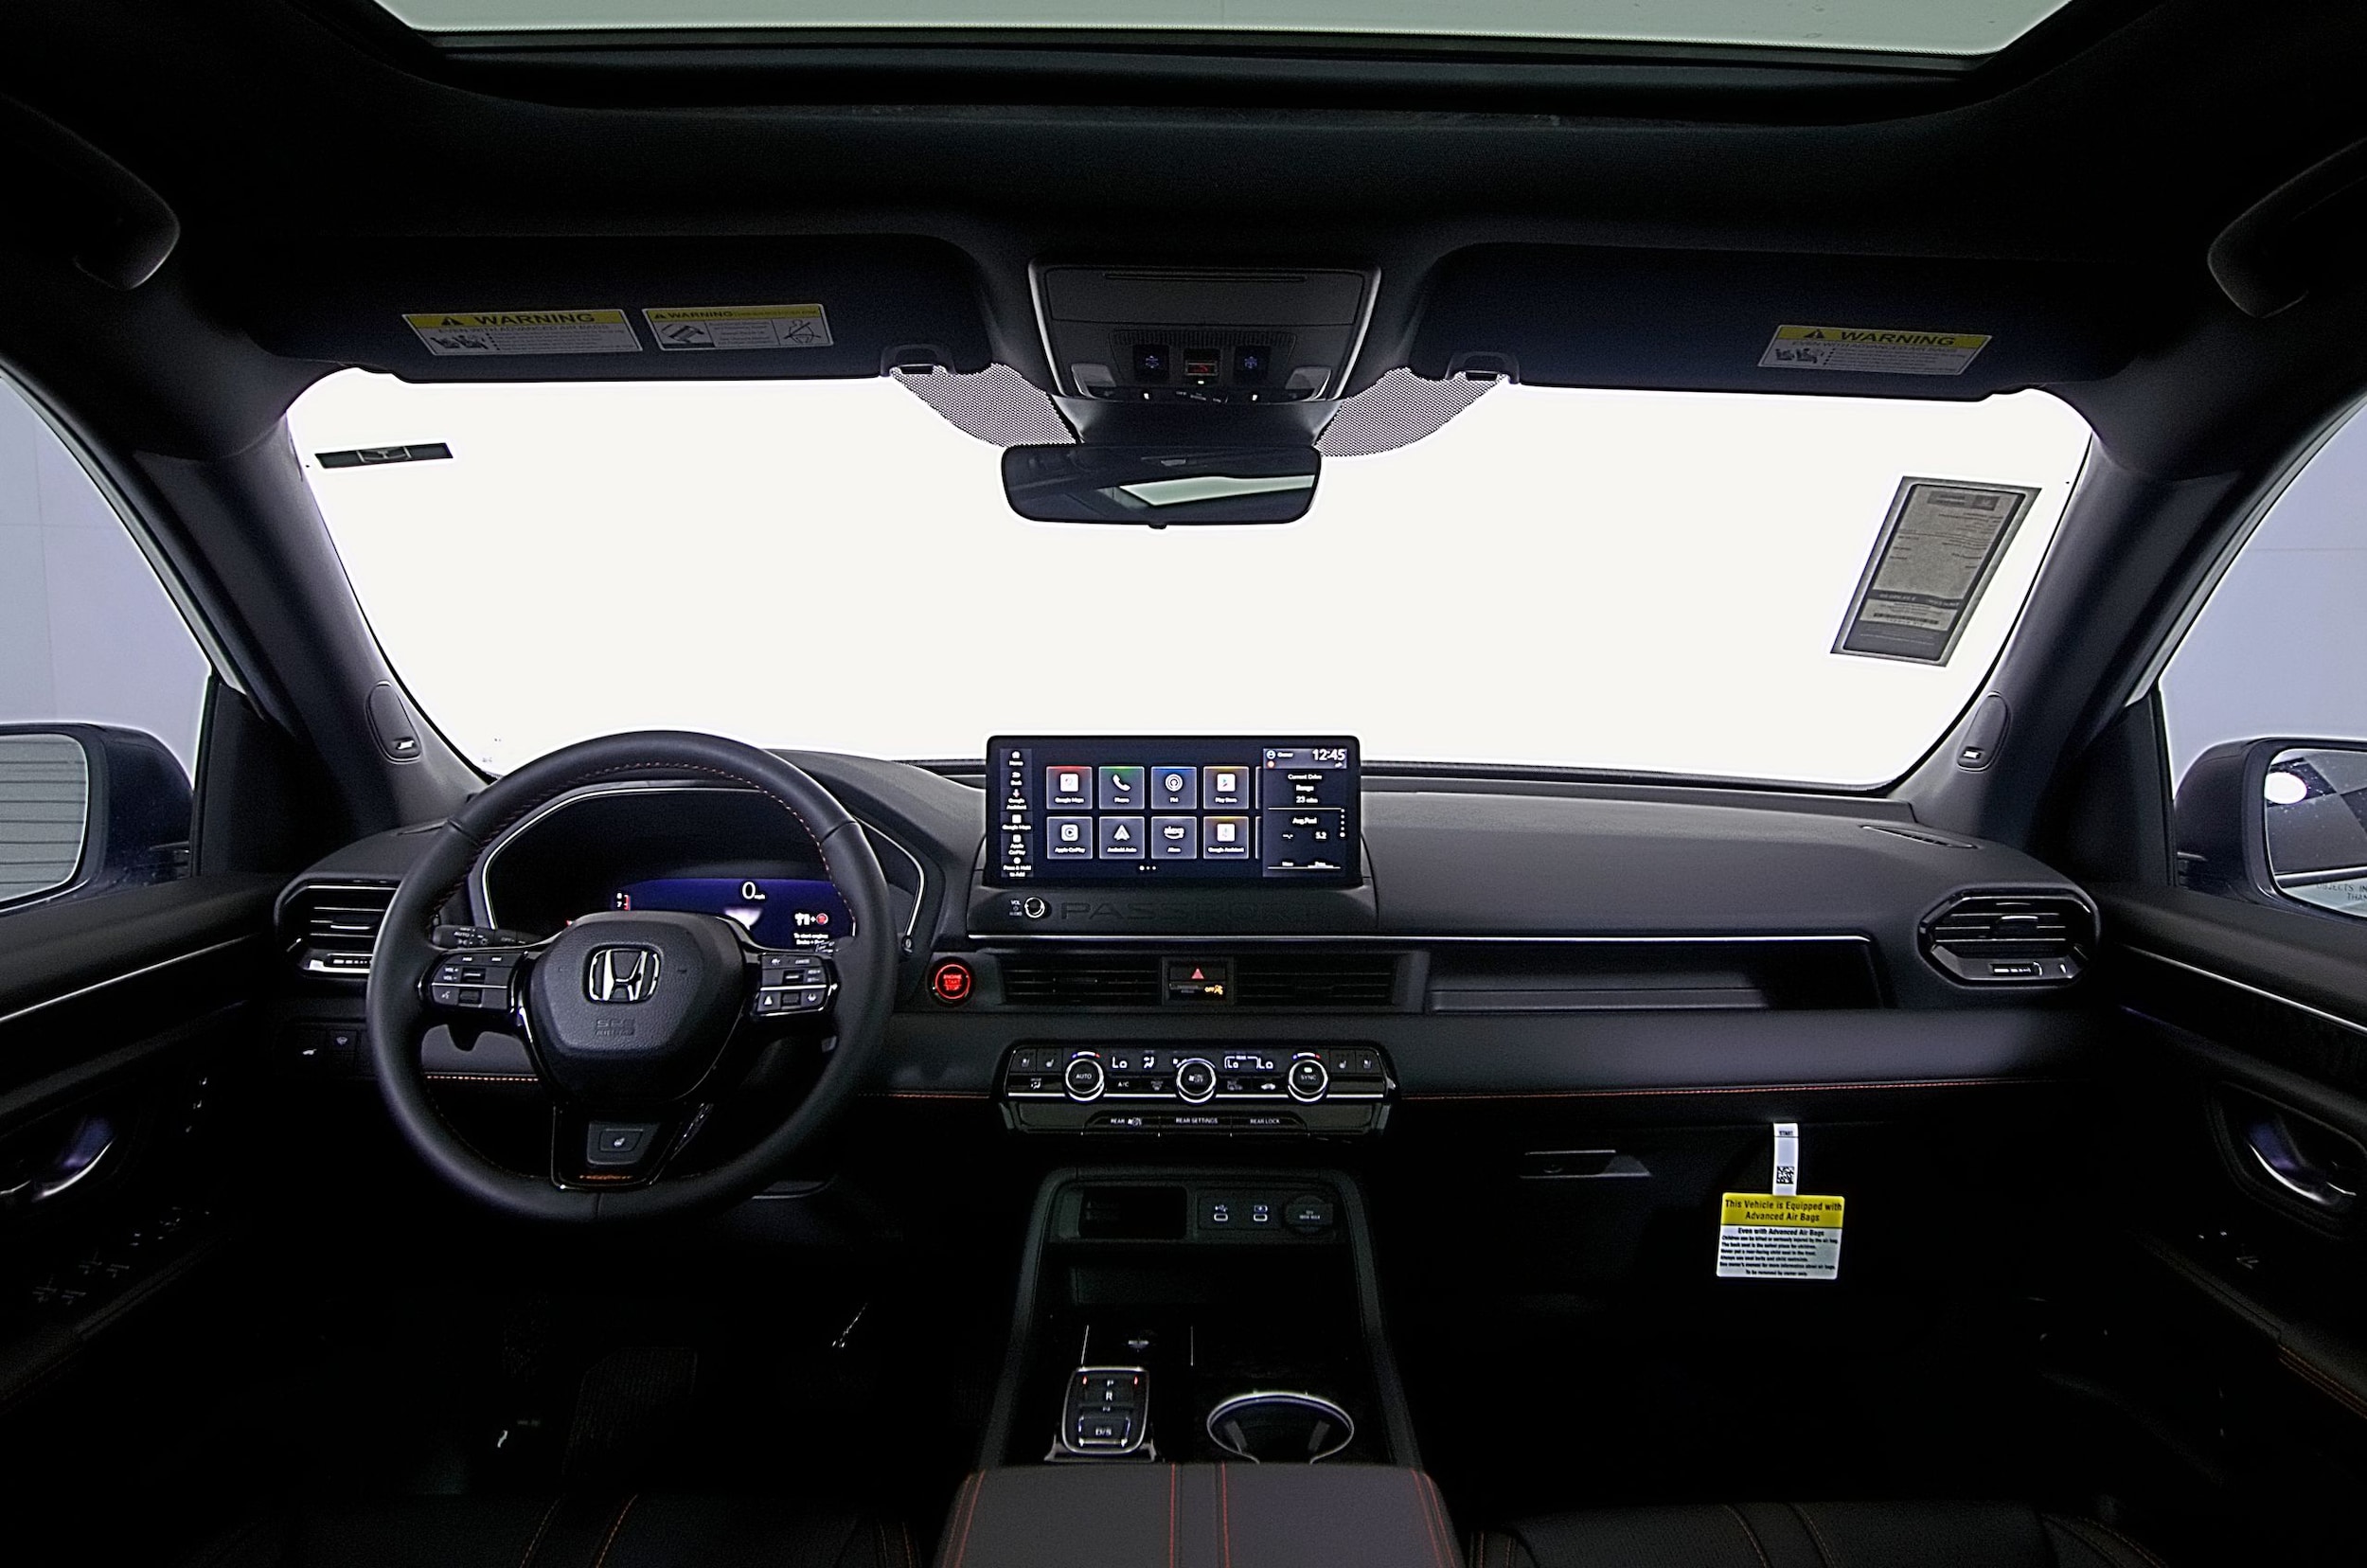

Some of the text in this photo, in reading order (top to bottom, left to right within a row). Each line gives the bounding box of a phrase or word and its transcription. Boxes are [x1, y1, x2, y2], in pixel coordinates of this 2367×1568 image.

[473, 312, 596, 327] WARNING
[1841, 330, 1956, 347] WARNING
[1312, 749, 1345, 761] 12:45
[741, 882, 756, 900] 0
[2317, 883, 2354, 892] OBJECTS
[1059, 900, 1327, 920] PASSPO
[1112, 1056, 1129, 1069] Lo
[1257, 1058, 1274, 1069] Lo
[1725, 1200, 1842, 1211] This Vehicle is Equipped with
[1745, 1211, 1820, 1222] Advanced Air Bags
[1105, 1390, 1113, 1402] R
[1095, 1427, 1112, 1437] D/S
